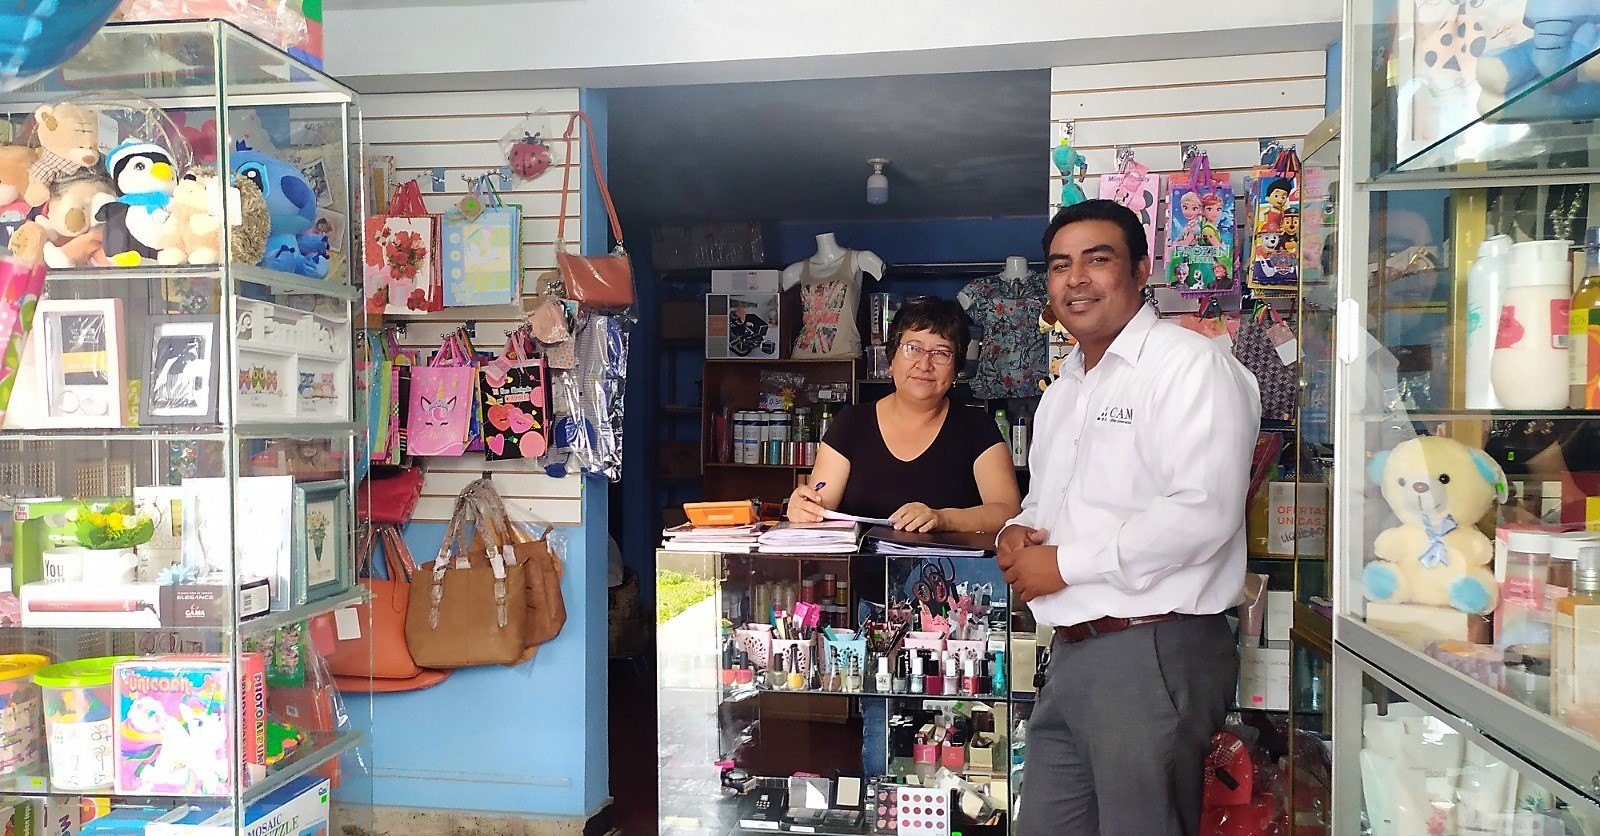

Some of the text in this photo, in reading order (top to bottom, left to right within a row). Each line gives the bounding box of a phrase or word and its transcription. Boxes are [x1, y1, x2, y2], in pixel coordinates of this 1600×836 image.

[1174, 244, 1230, 258] FROZEN
[1277, 506, 1327, 515] OFRTAS
[253, 671, 264, 719] PHOTO
